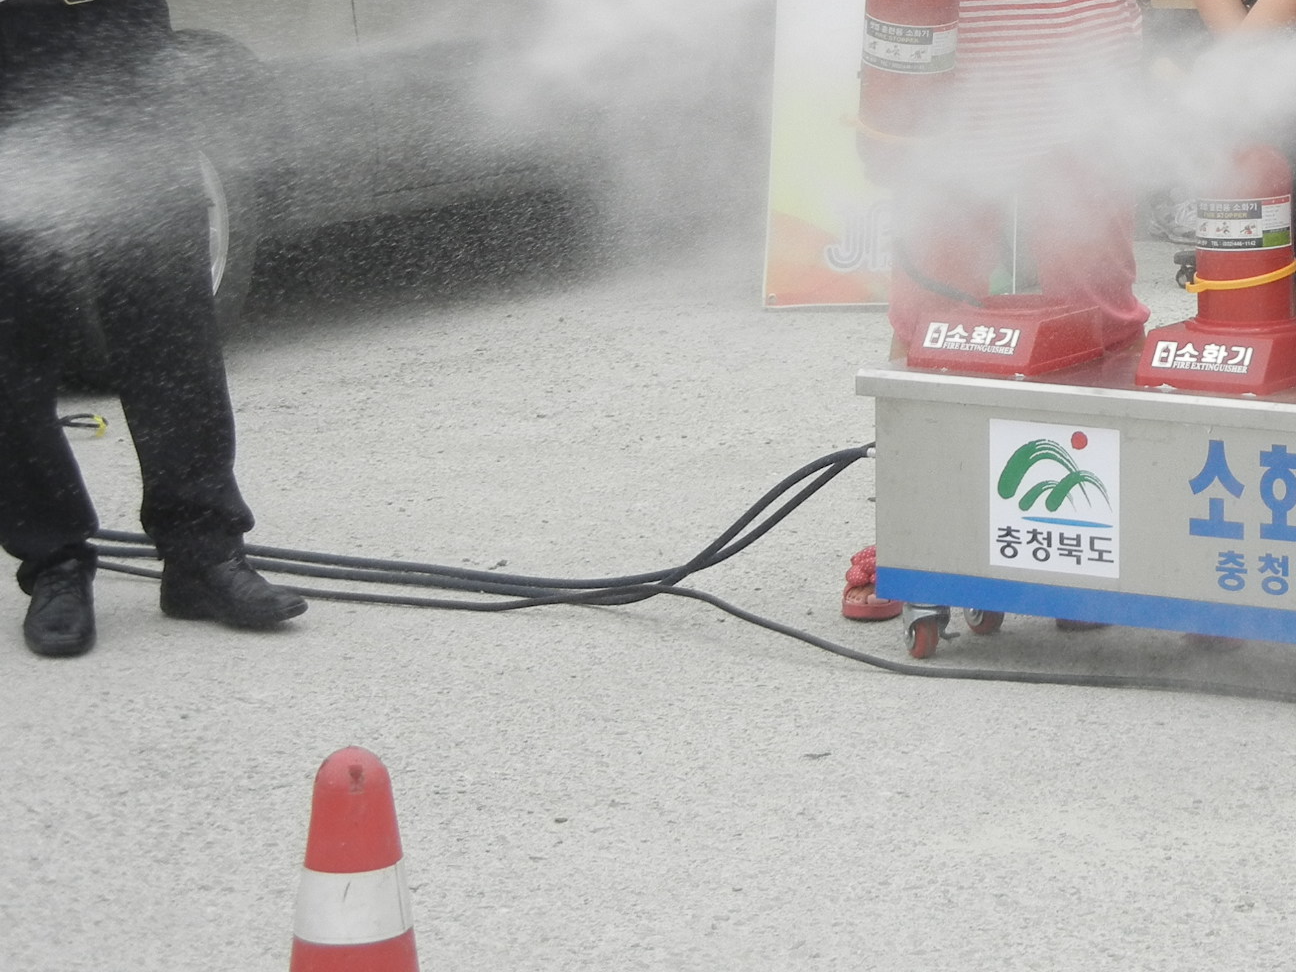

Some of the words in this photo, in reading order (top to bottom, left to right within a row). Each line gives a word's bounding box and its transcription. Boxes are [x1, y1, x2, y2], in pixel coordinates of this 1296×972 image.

[1233, 202, 1258, 212] 소화기
[946, 324, 1021, 348] 소화기
[942, 342, 960, 350] FIRE
[960, 343, 1015, 356] EXTINGUISHER
[1175, 342, 1254, 366] 소화기
[1172, 361, 1191, 370] FIRE
[1190, 362, 1249, 374] EXTINGUISHER
[995, 525, 1115, 566] 충청북도
